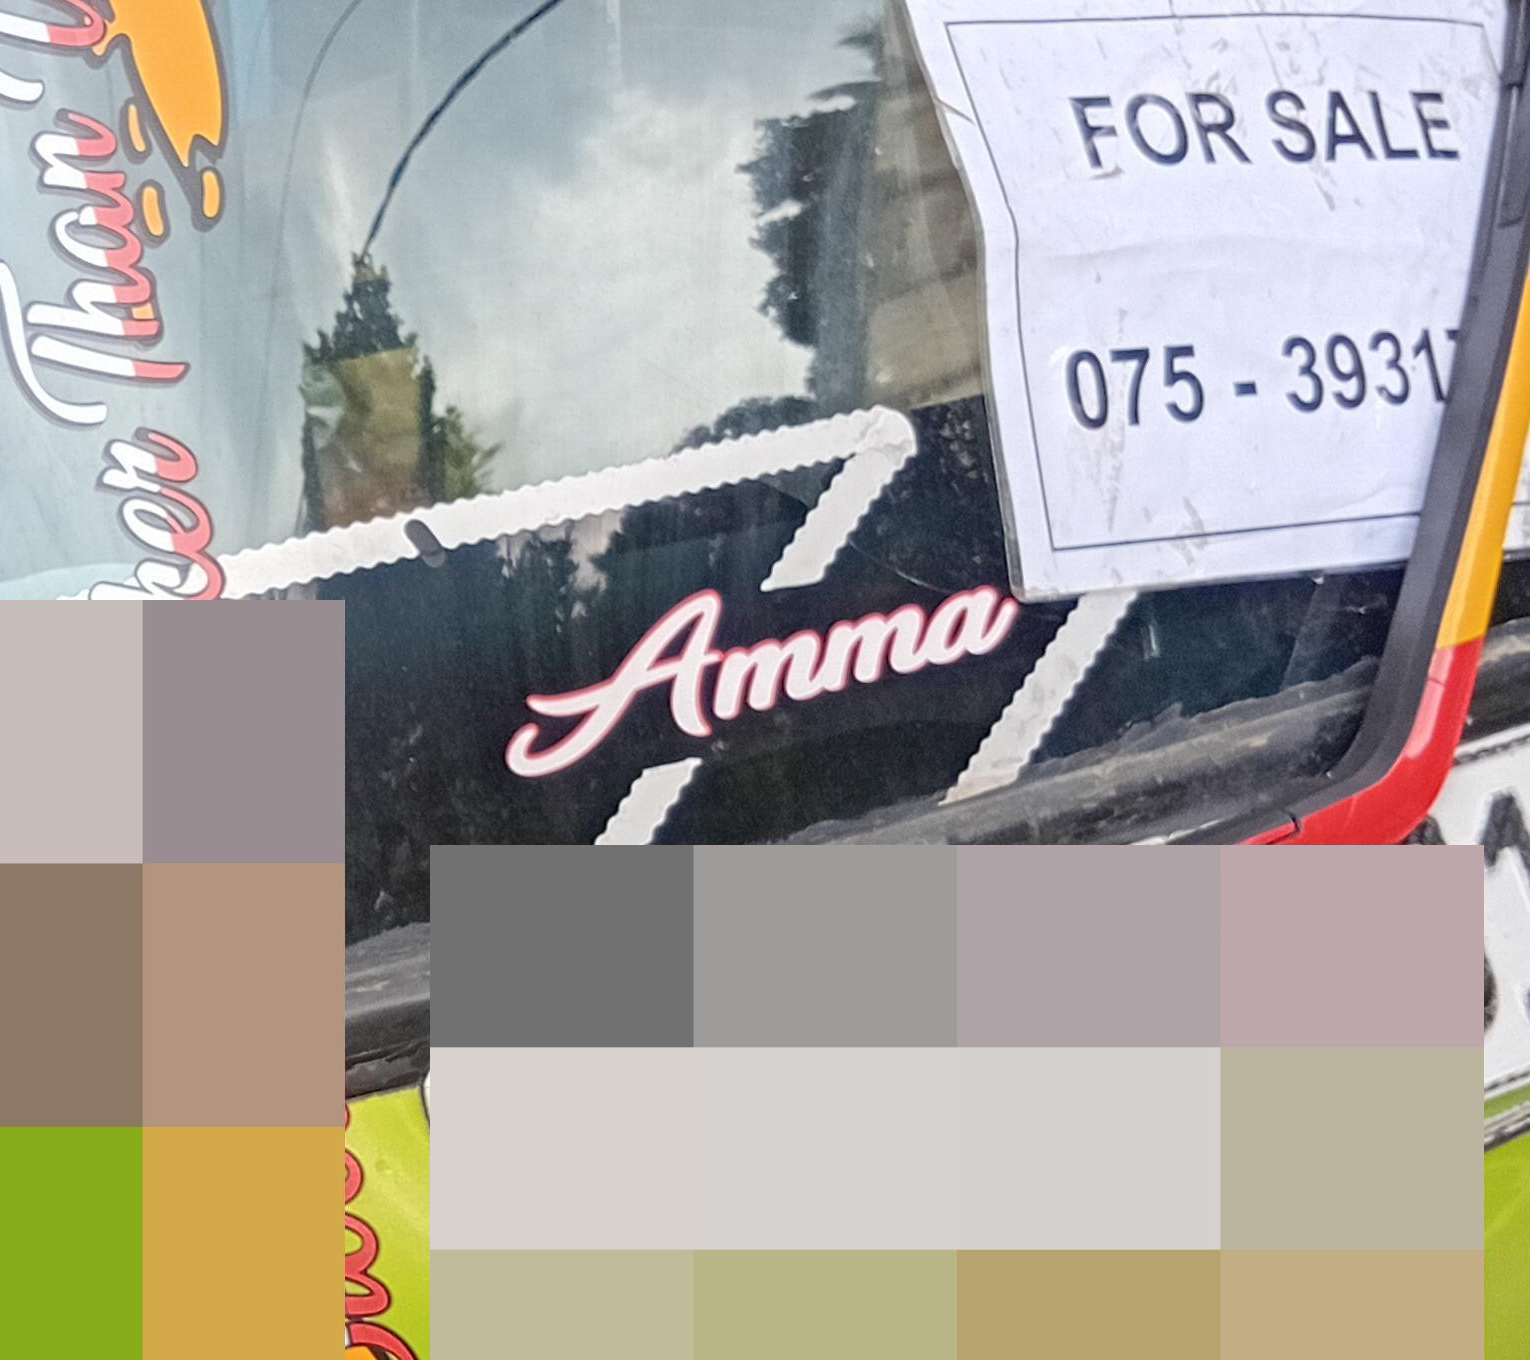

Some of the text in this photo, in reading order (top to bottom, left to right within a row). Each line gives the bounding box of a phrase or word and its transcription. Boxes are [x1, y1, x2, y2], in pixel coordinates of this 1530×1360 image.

[1070, 90, 1460, 169] FOR SALE
[1065, 344, 1205, 430] 075
[1280, 328, 1458, 412] 3931
[505, 587, 1020, 777] Amma
